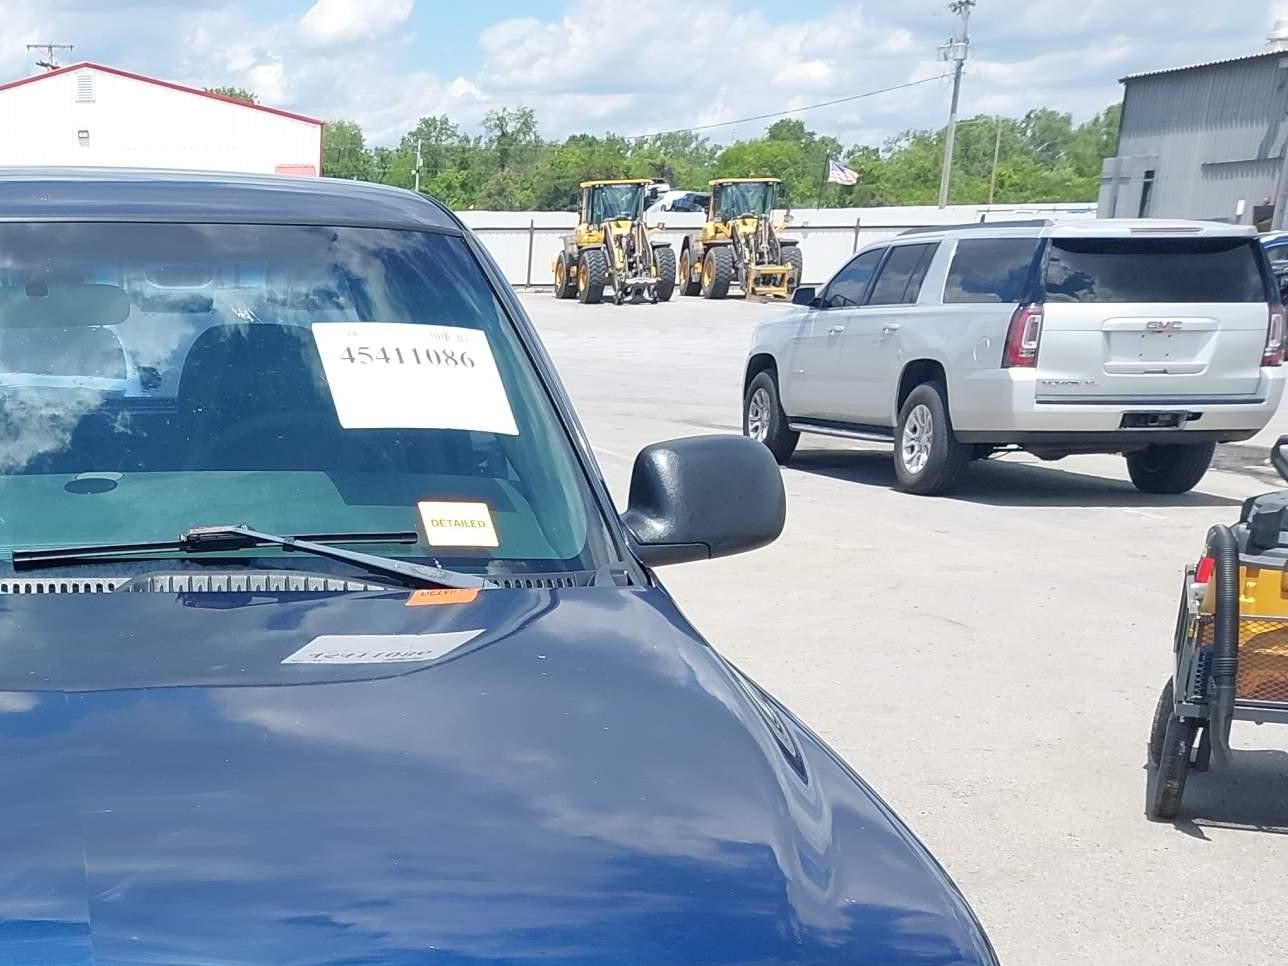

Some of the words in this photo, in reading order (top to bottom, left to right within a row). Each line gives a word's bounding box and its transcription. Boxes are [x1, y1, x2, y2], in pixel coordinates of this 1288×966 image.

[1145, 320, 1184, 330] GMC
[340, 346, 476, 369] 45411086
[430, 519, 487, 528] DETAILED
